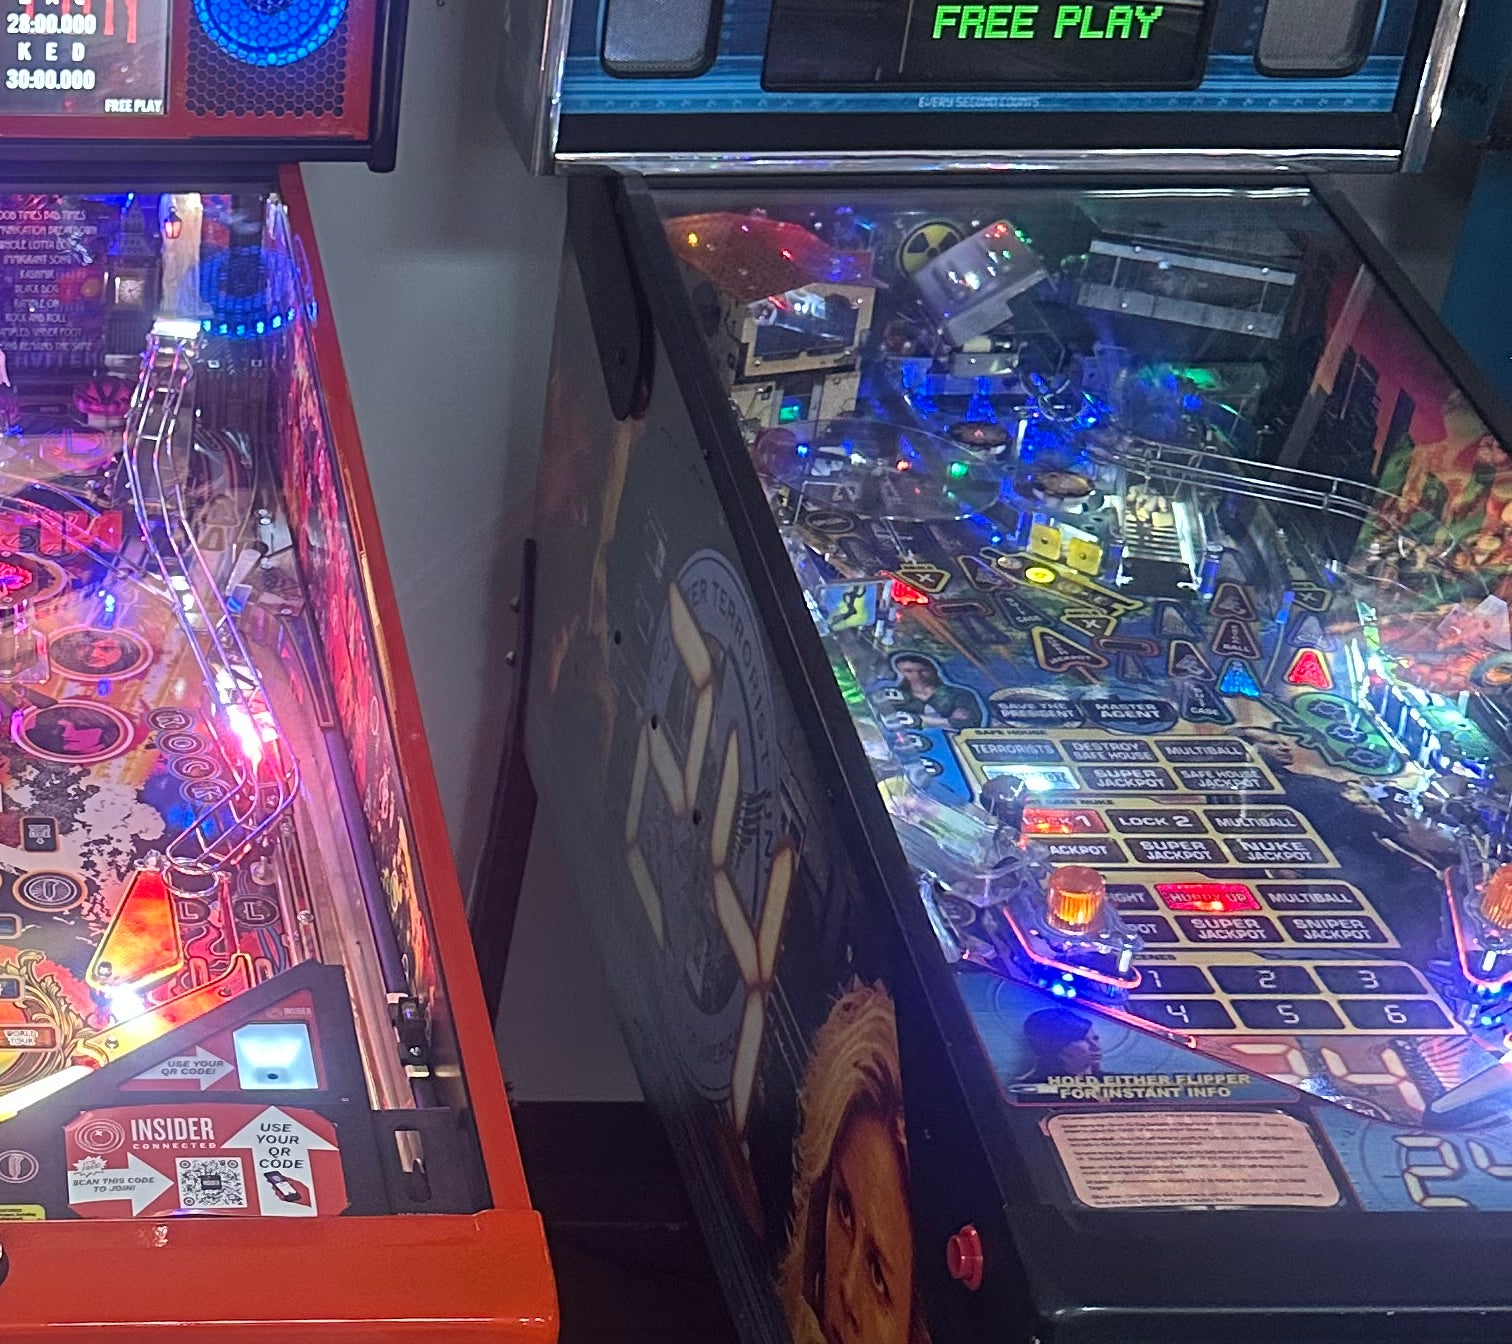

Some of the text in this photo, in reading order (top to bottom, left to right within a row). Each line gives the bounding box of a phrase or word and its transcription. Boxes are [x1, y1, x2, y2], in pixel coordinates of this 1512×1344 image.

[6, 13, 96, 34] 28:00.000
[932, 5, 1164, 39] FREE PLAY
[5, 68, 96, 90] 30:00.000
[104, 99, 163, 114] FREE PLAY
[1095, 703, 1158, 712] MASTER
[1100, 710, 1162, 719] AGENT
[972, 744, 1056, 755] TERRORISTS
[1071, 742, 1139, 752] DESTROY
[1167, 745, 1242, 756] MULTIBALL
[1073, 752, 1153, 762] SAFE HOUSE
[1094, 769, 1157, 779] SUPER
[1096, 778, 1166, 788] JACKPOT
[1197, 779, 1261, 789] JACKPOT
[1118, 815, 1193, 828] LOCK 2
[1216, 817, 1296, 828] MULTIBALL
[1142, 841, 1207, 851] SUPER
[1239, 841, 1308, 851] NUKE
[1146, 850, 1213, 860] JACKPOT
[1243, 851, 1313, 861] JACKPOT
[1226, 893, 1248, 903] UP
[1268, 892, 1353, 904] MULTIBALL
[1190, 918, 1260, 930] SUPER
[1292, 918, 1366, 930] SNIPER
[1197, 929, 1267, 940] JACKPOT
[1302, 929, 1372, 941] JACKPOT
[1148, 970, 1380, 989] 1 2 3
[1166, 1004, 1408, 1024] 4 5 6
[167, 1060, 224, 1069] USE YOUR
[160, 1067, 217, 1077] QR CODE!
[1047, 1073, 1251, 1087] HOLD EITHER FLIPPER
[1059, 1086, 1232, 1099] FOR INSTANT INFO
[130, 1117, 216, 1142] INSIDER
[260, 1123, 292, 1133] USE
[256, 1135, 300, 1146] YOUR
[268, 1147, 292, 1158] QR
[258, 1159, 305, 1170] CODE
[72, 1176, 156, 1187] SCAN THIS CODE
[93, 1185, 105, 1194] TO
